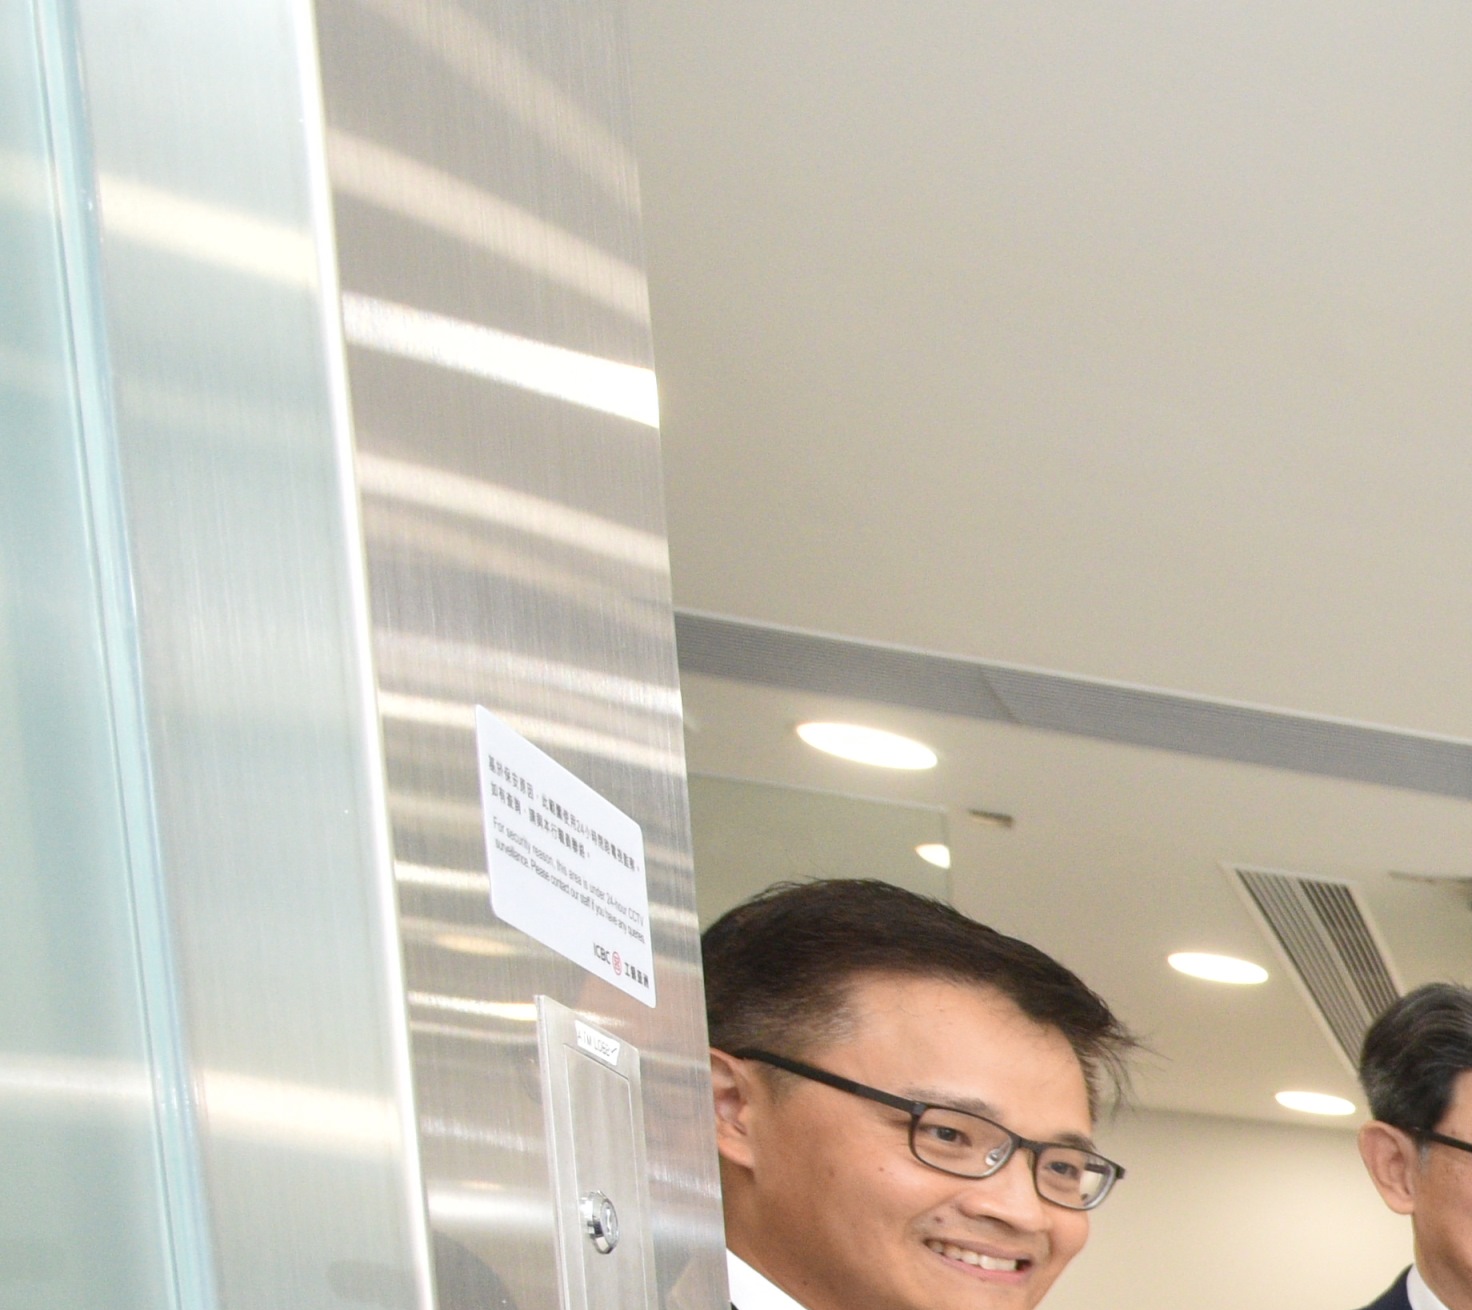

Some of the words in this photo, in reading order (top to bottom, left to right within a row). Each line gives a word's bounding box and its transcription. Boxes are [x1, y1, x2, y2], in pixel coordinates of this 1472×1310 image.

[493, 817, 504, 834] For
[506, 825, 531, 855] security
[589, 881, 605, 901] under
[627, 906, 644, 926] CCTV
[530, 859, 548, 880] Please
[593, 942, 610, 964] ICBC
